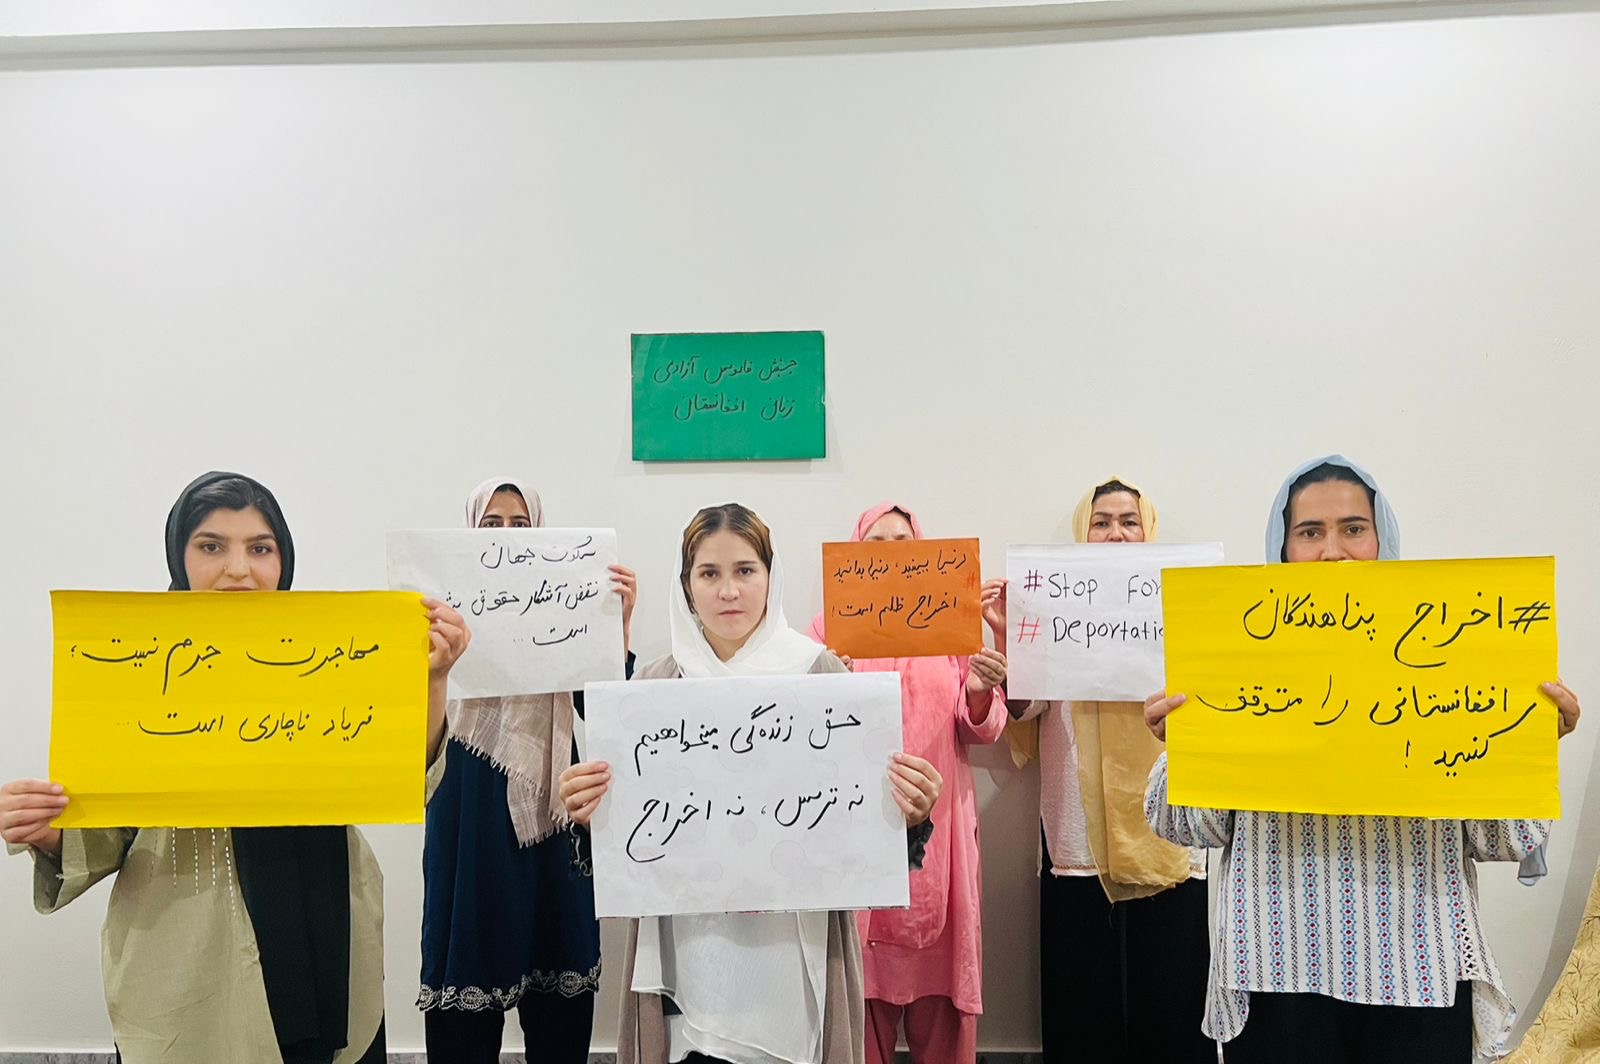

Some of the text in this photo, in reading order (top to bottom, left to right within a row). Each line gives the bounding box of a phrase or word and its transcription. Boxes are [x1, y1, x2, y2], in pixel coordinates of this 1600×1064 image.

[653, 355, 798, 385] جنبش فانوس آزادی
[674, 392, 795, 421] زنان افغانستان
[480, 535, 597, 570] سکوت جهان
[867, 556, 889, 581] دنیا
[937, 549, 967, 575] دنیا
[833, 559, 865, 584] بدانید
[470, 589, 521, 617] حقوق
[519, 579, 569, 617] آشکار
[564, 581, 599, 611] نقض
[1127, 574, 1162, 604] For
[879, 596, 904, 627] ظلم
[906, 591, 957, 629] اخراج
[1242, 588, 1377, 641] پناهندگان
[1017, 616, 1164, 649] #Deportati
[162, 637, 222, 696] جرم
[245, 636, 380, 678] مهاجرت
[1195, 674, 1509, 727] افغانستانی را متوقف
[238, 710, 310, 743] ناچاری
[322, 705, 375, 743] فریاد
[808, 707, 862, 750] حق
[725, 795, 745, 816] نه
[847, 784, 864, 812] نه
[626, 791, 712, 864] اخراج
